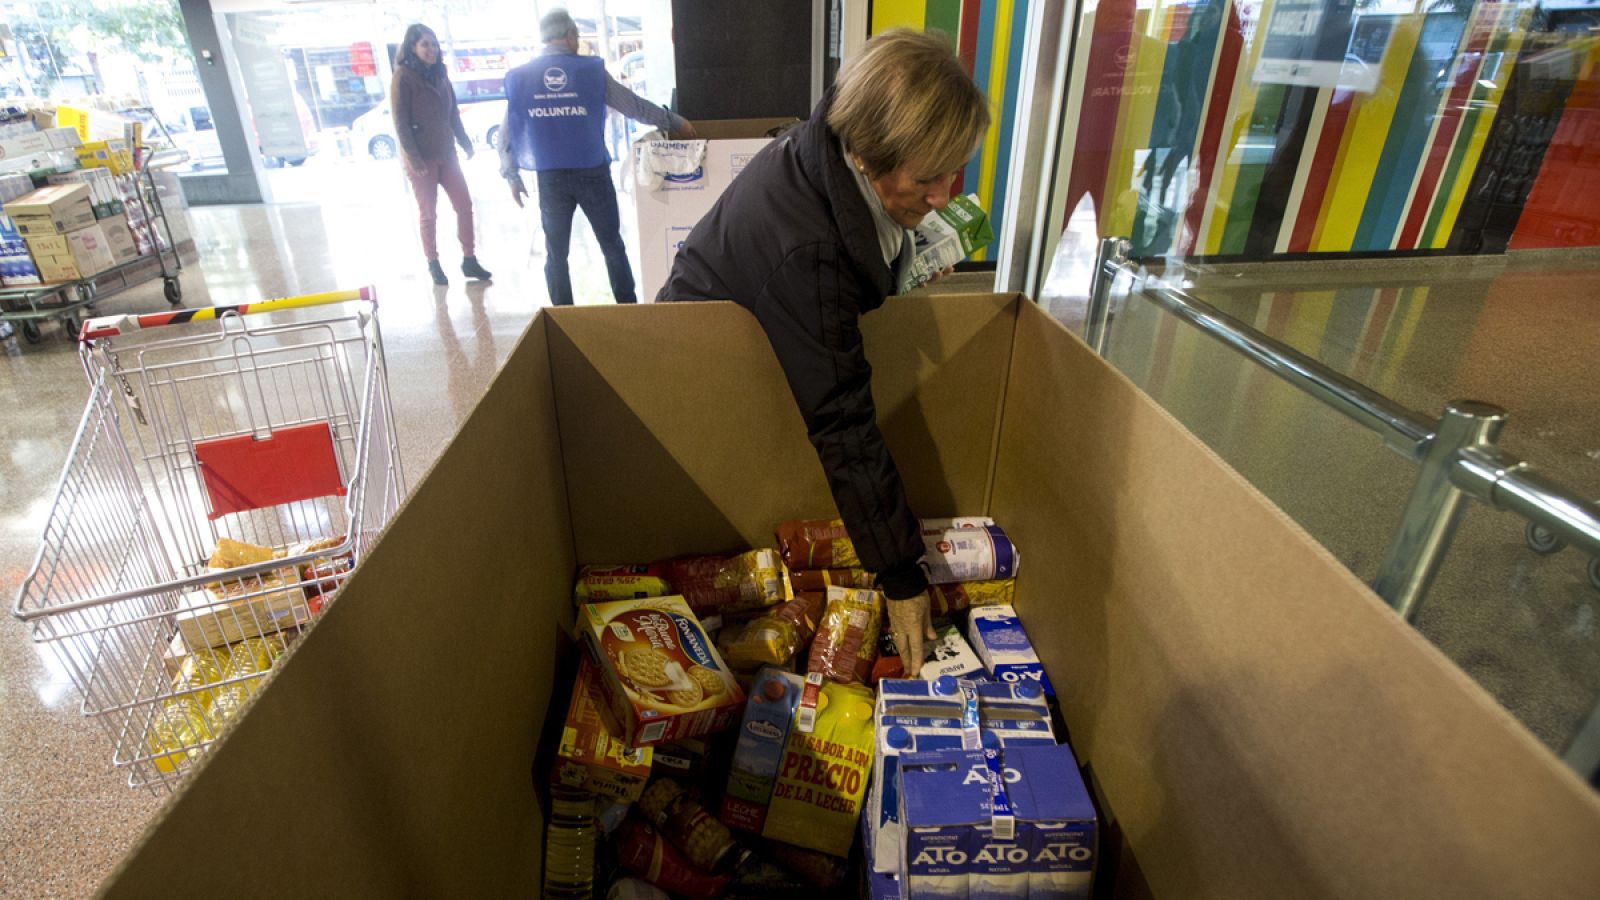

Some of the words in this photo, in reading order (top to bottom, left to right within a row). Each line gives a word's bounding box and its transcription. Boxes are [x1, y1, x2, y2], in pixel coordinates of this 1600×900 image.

[675, 617, 711, 666] FONTANEDA
[791, 733, 804, 749] TU
[807, 737, 844, 759] SABOR
[843, 747, 854, 760] A
[781, 752, 861, 796] PRECIO
[962, 764, 1022, 785] AO
[774, 782, 794, 797] DE
[795, 786, 813, 802] LA
[816, 793, 856, 815] LECHE
[912, 846, 968, 866] ATO
[972, 843, 1029, 864] ATO
[1033, 843, 1092, 863] ATO
